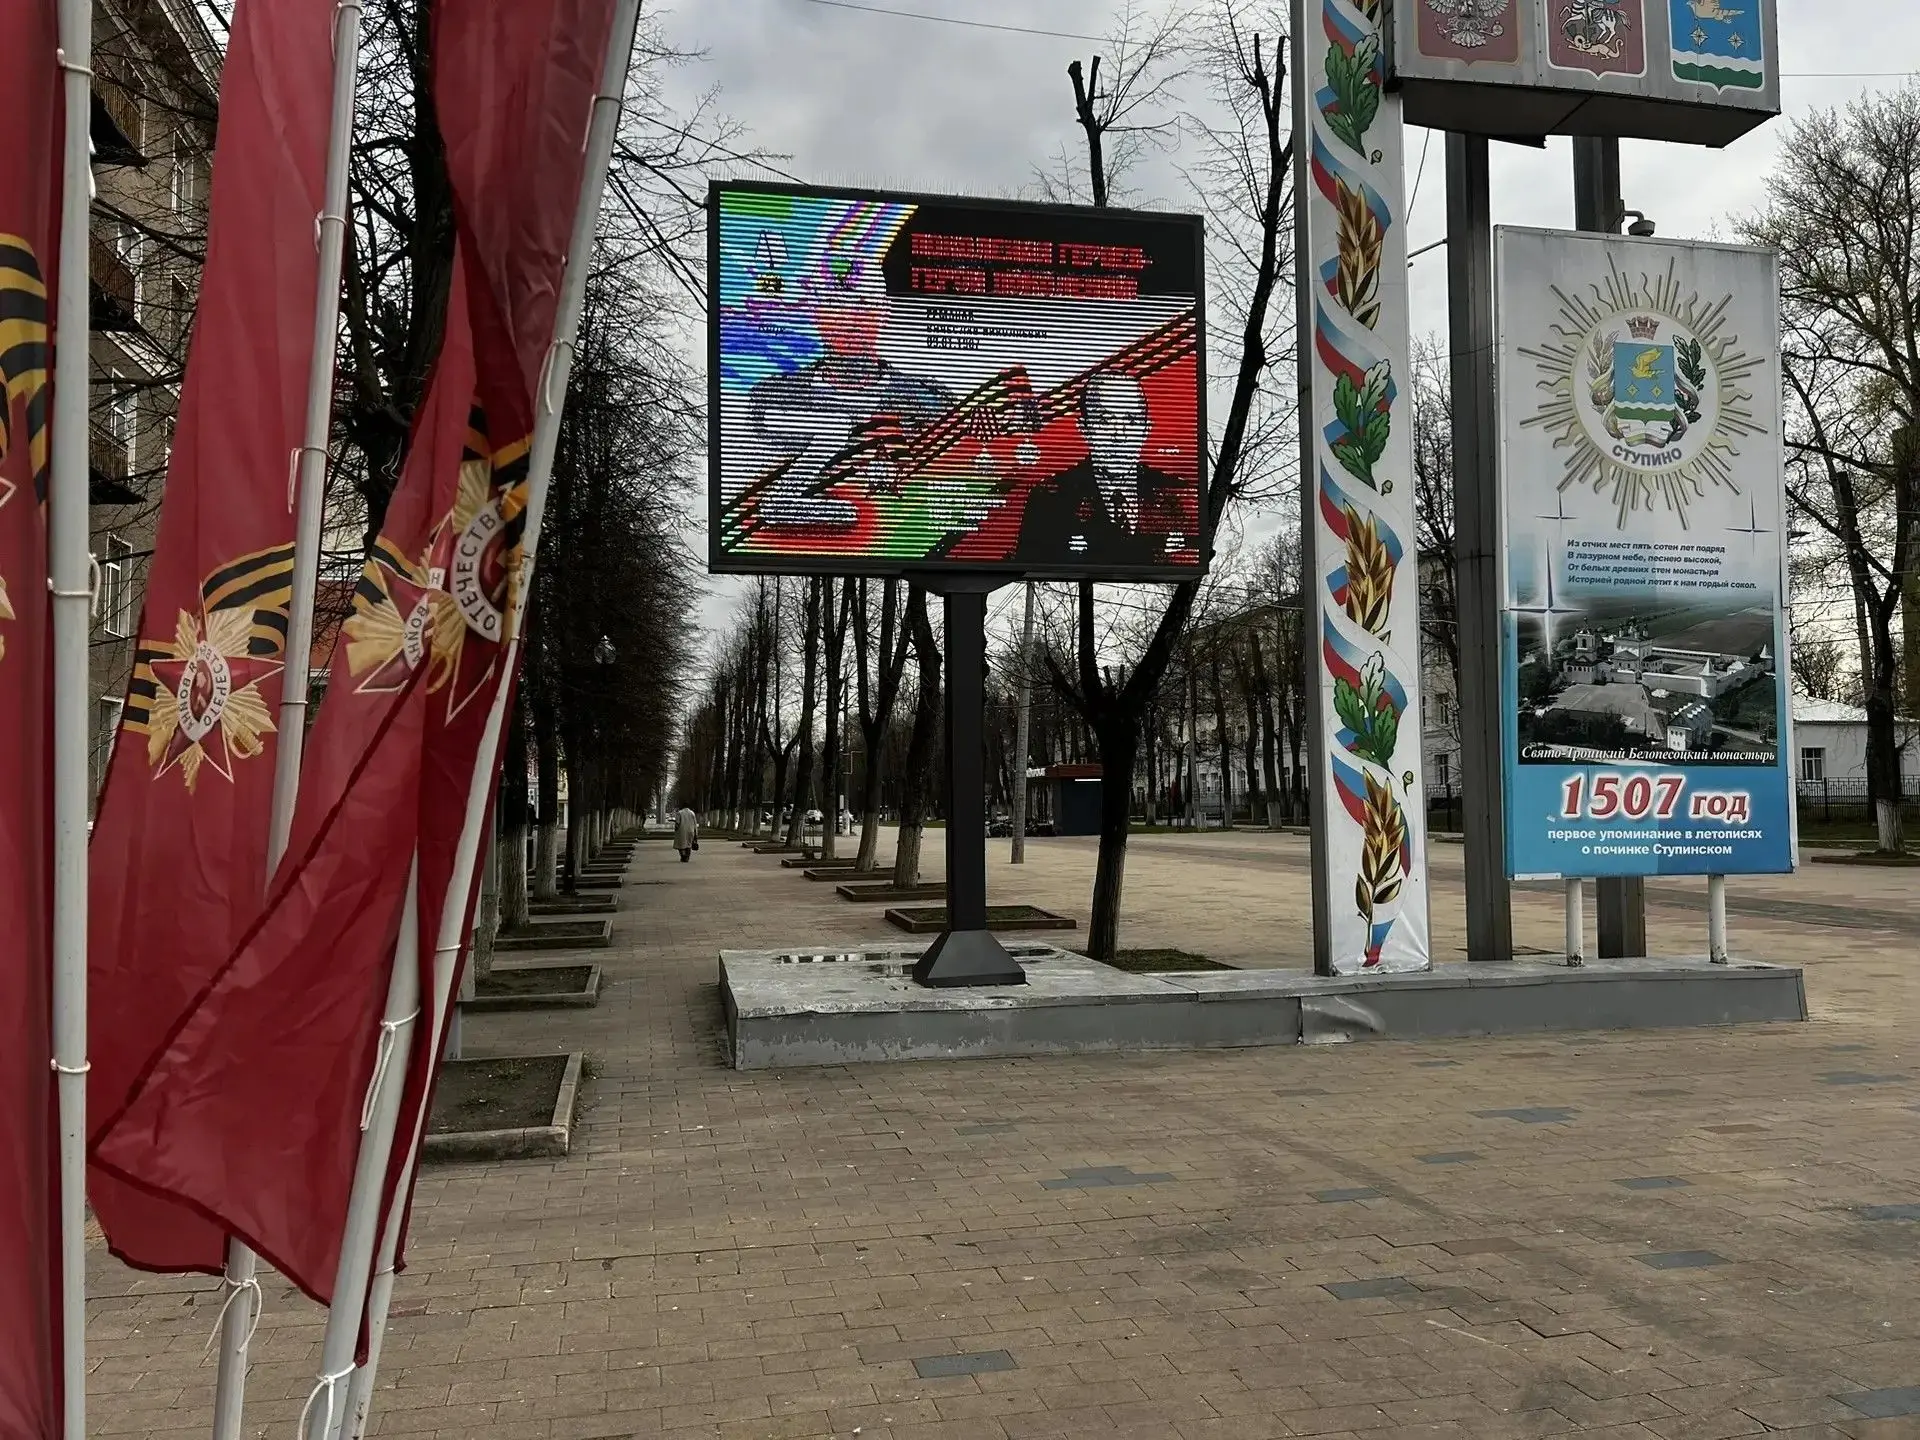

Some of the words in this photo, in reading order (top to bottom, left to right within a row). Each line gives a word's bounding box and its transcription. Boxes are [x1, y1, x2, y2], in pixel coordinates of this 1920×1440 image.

[1612, 444, 1683, 467] СТУПИНО
[1567, 539, 1580, 547] Из
[1582, 540, 1607, 549] отчих
[1609, 541, 1631, 550] мест
[1633, 542, 1652, 551] пять
[1653, 543, 1679, 551] сотен
[1680, 544, 1695, 552] лет
[1696, 545, 1726, 554] подряд
[1567, 551, 1574, 559] В
[1576, 551, 1621, 561] лазурном
[1622, 553, 1647, 562] небе,
[1648, 554, 1682, 562] песнею
[1684, 556, 1722, 565] высокой,
[1567, 563, 1580, 571] От
[1581, 563, 1610, 572] белых
[1611, 565, 1649, 574] древних
[1651, 566, 1671, 574] стен
[1672, 567, 1719, 577] монастыря
[1568, 575, 1612, 585] Историей
[1613, 576, 1646, 586] родной
[1648, 579, 1672, 587] летит
[1680, 580, 1697, 588] нам
[1698, 580, 1729, 589] гордый
[1730, 581, 1757, 589] сокол.
[1521, 746, 1626, 762] Свято-Троицкий
[1628, 747, 1709, 763] Белопесоцкий
[1710, 750, 1775, 764] монастырь
[1563, 774, 1685, 818] 1507
[1690, 793, 1749, 822] год
[1547, 829, 1597, 843] первое
[1599, 830, 1683, 843] упоминание
[1685, 830, 1693, 840] в
[1695, 830, 1763, 840] летописях
[1581, 845, 1590, 855] о
[1593, 845, 1650, 855] починке
[1652, 844, 1733, 857] Ступинском
